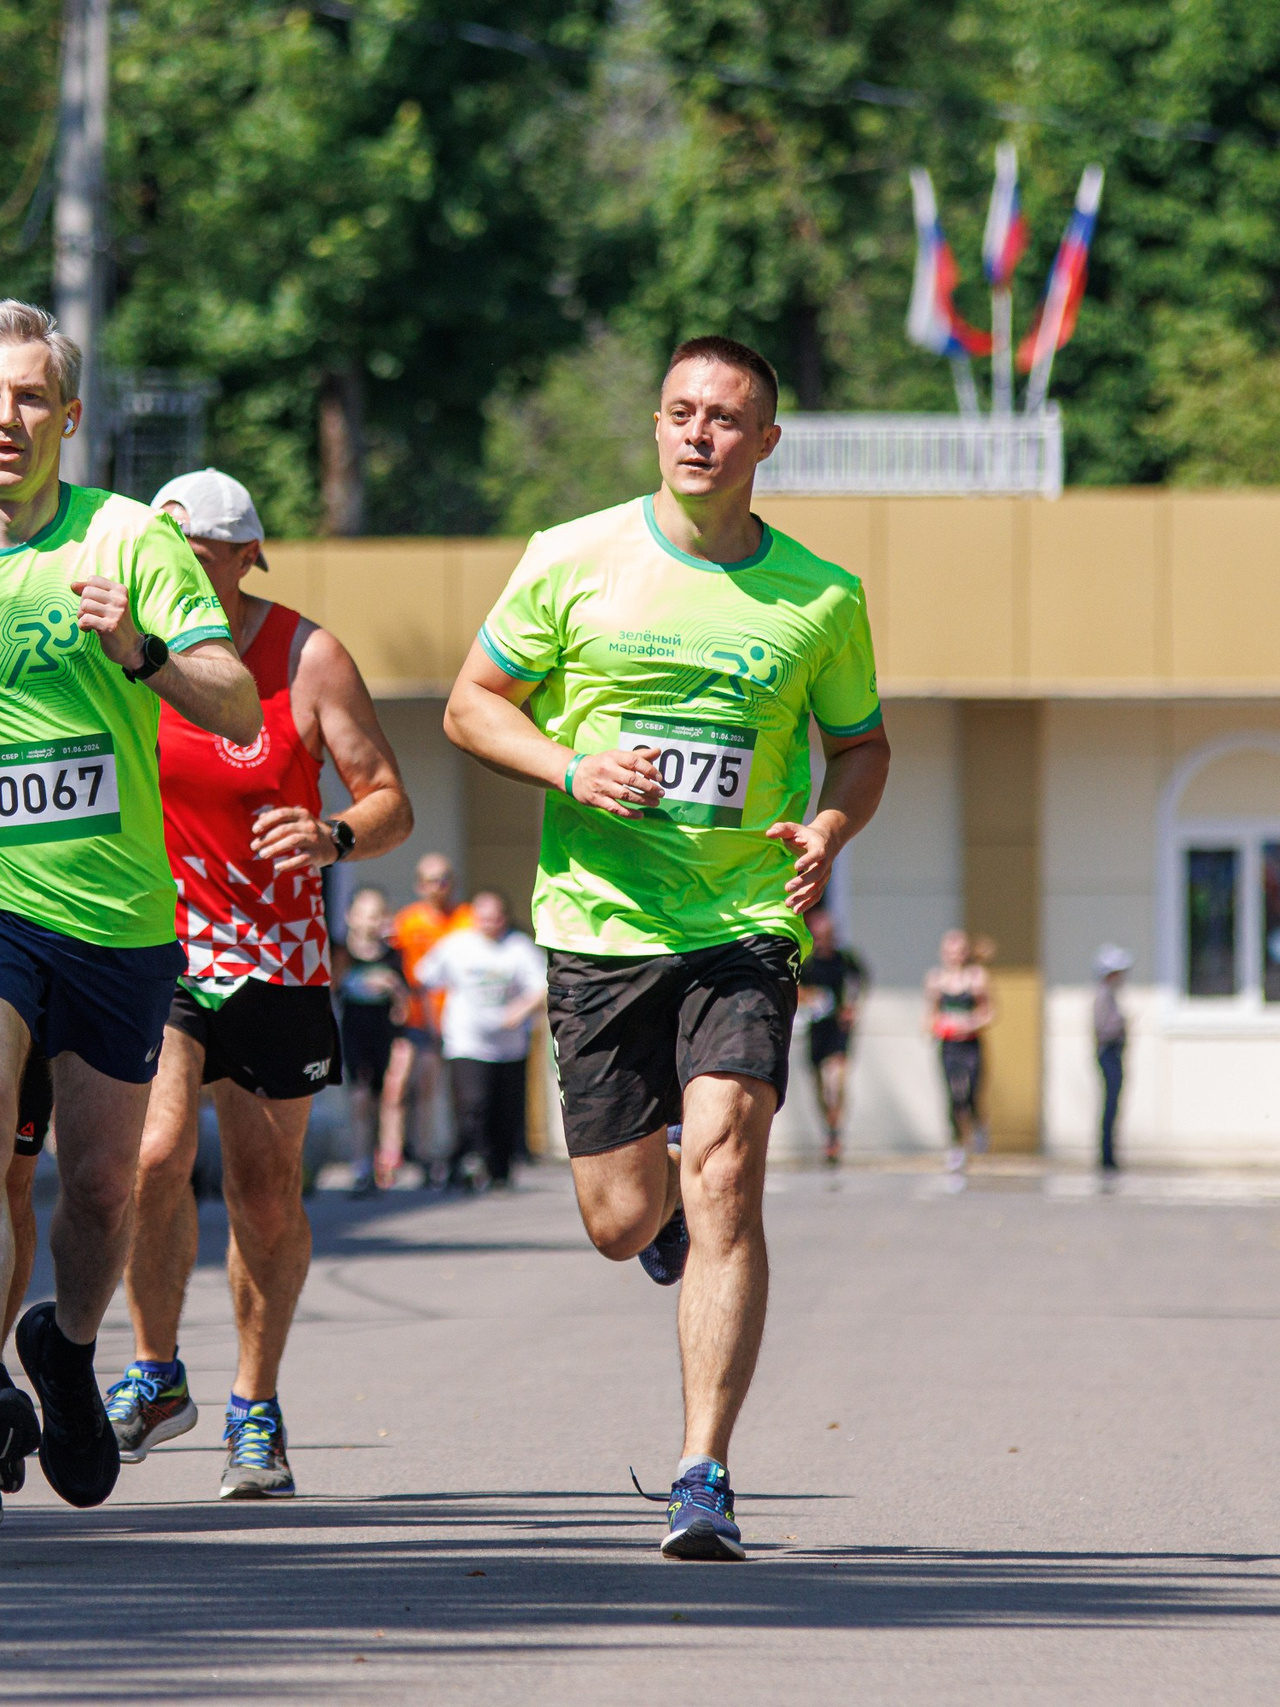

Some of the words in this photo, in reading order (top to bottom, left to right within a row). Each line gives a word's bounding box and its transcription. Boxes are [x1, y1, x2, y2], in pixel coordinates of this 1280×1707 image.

[194, 595, 222, 609] СБЕ
[618, 629, 682, 646] зелёный
[609, 643, 675, 658] марафон
[644, 722, 664, 731] СБЕР
[710, 731, 745, 743] 01.06.2024
[62, 743, 100, 754] 01.06.2024
[1, 753, 19, 761] СБЕР
